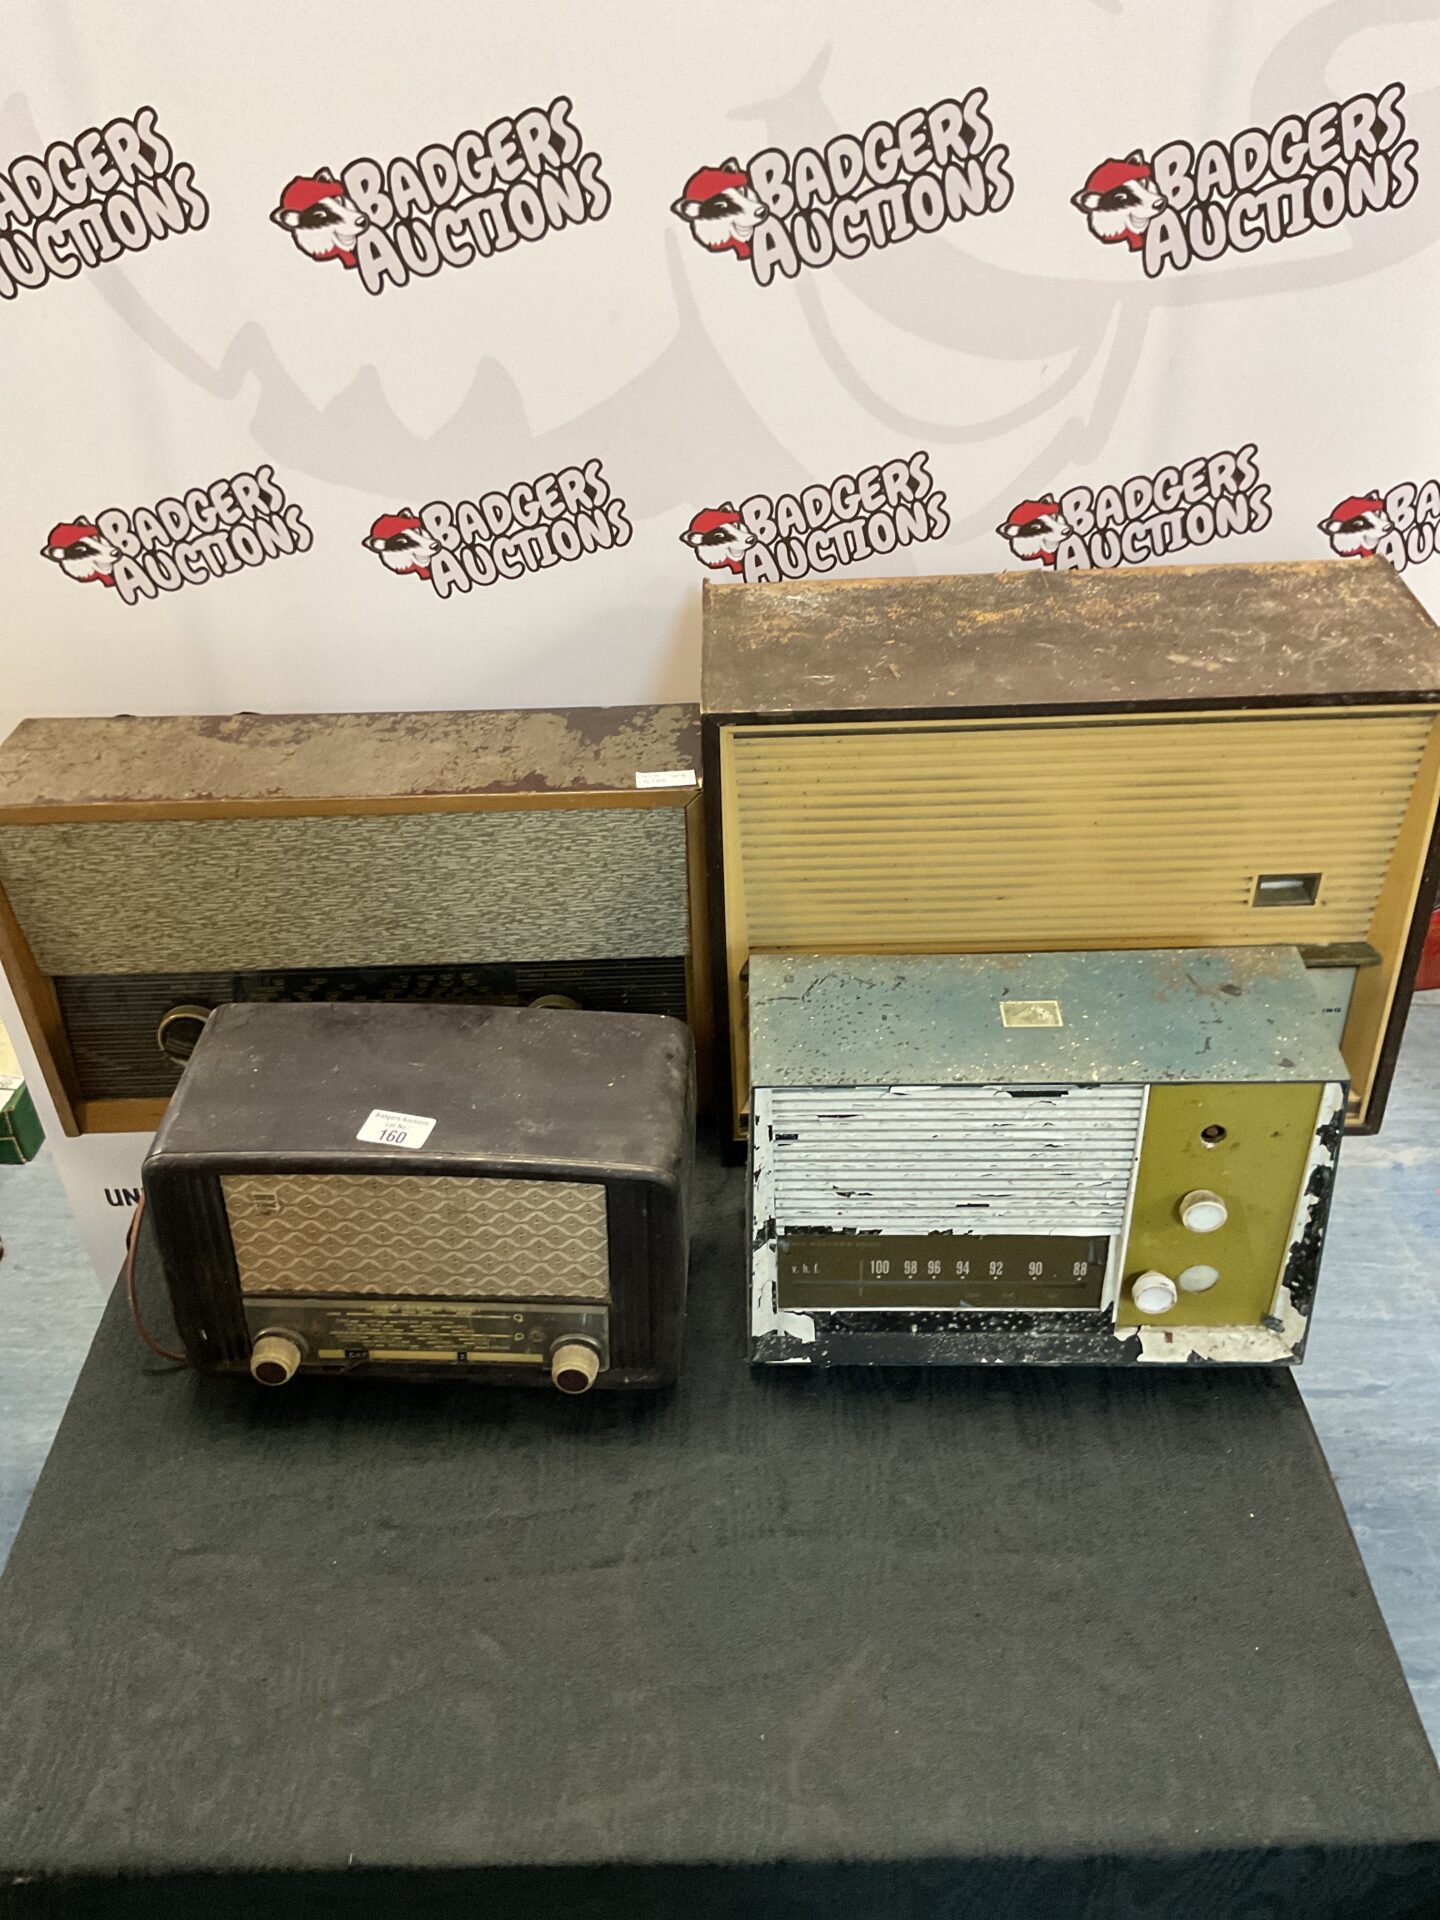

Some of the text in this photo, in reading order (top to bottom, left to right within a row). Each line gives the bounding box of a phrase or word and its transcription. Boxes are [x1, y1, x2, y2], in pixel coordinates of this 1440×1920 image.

[342, 96, 582, 228] BADGERS
[749, 87, 993, 218] BADGERS
[1152, 82, 1405, 209] BADGERS
[356, 152, 611, 295] AUCTIONS
[751, 144, 1014, 287] AUCTIONS
[1142, 139, 1418, 278] AUCTIONS
[100, 465, 285, 556] BADGERS
[421, 459, 609, 549] BADGERS
[740, 450, 933, 545] BADGERS
[744, 491, 950, 583] AUCTIONS
[1056, 484, 1272, 571] AUCTIONS
[1060, 443, 1259, 537] BADGERS
[112, 504, 313, 605] AUCTIONS
[430, 499, 632, 599] AUCTIONS
[379, 1128, 408, 1144] 160
[870, 1260, 890, 1275] 100
[904, 1260, 918, 1275] 98
[927, 1260, 941, 1275] 96
[955, 1260, 970, 1276] 94
[989, 1261, 1004, 1276] 92
[1028, 1261, 1043, 1276] 90
[1073, 1262, 1087, 1277] 88
